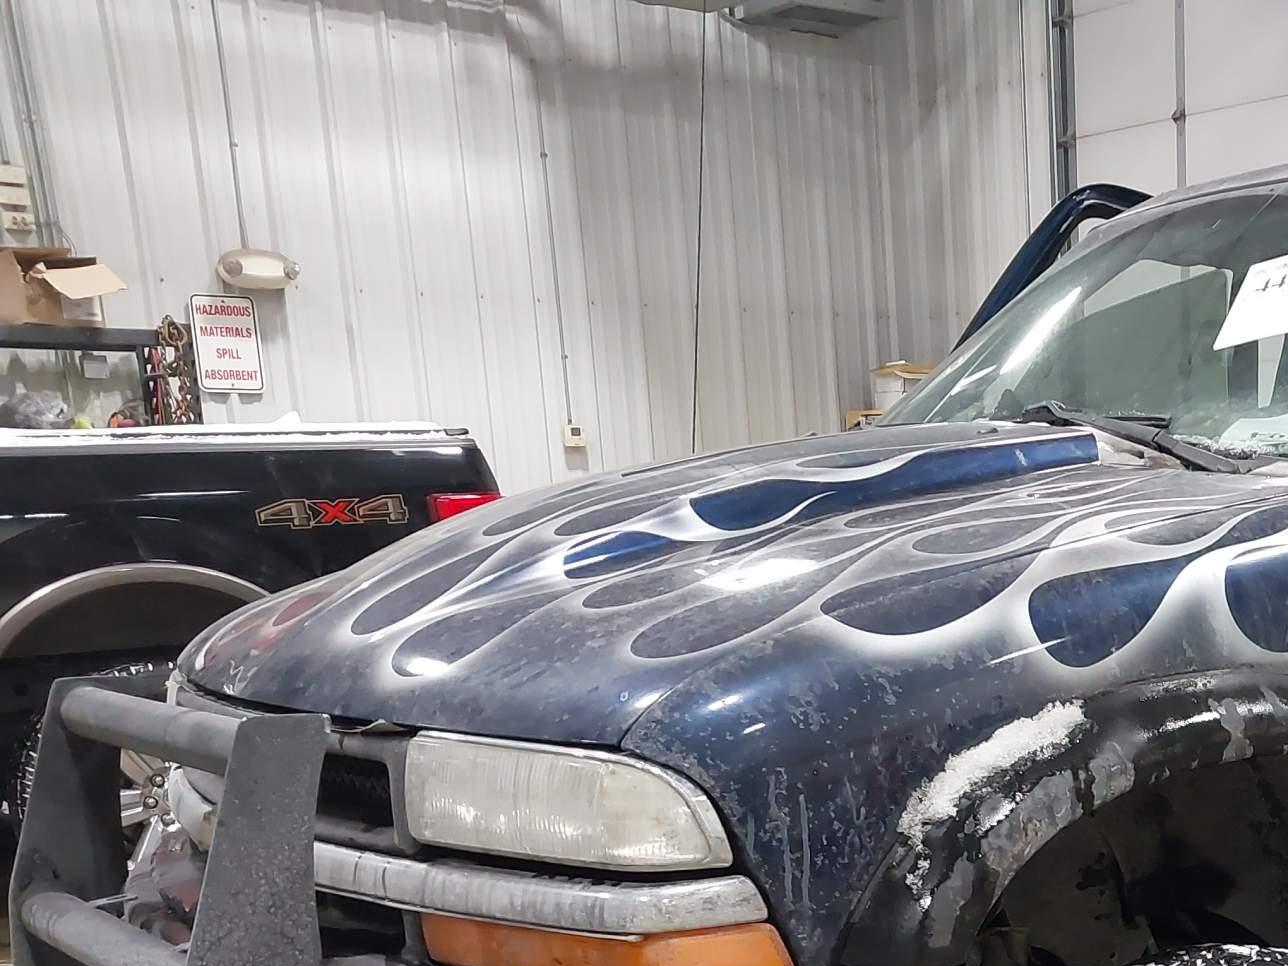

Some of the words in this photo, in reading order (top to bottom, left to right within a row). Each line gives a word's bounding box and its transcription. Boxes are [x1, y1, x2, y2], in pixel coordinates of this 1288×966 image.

[195, 304, 252, 318] HAZARDOUS
[200, 326, 252, 338] MATERIALS
[216, 348, 242, 360] SPILL
[204, 370, 258, 381] ABSORBENT
